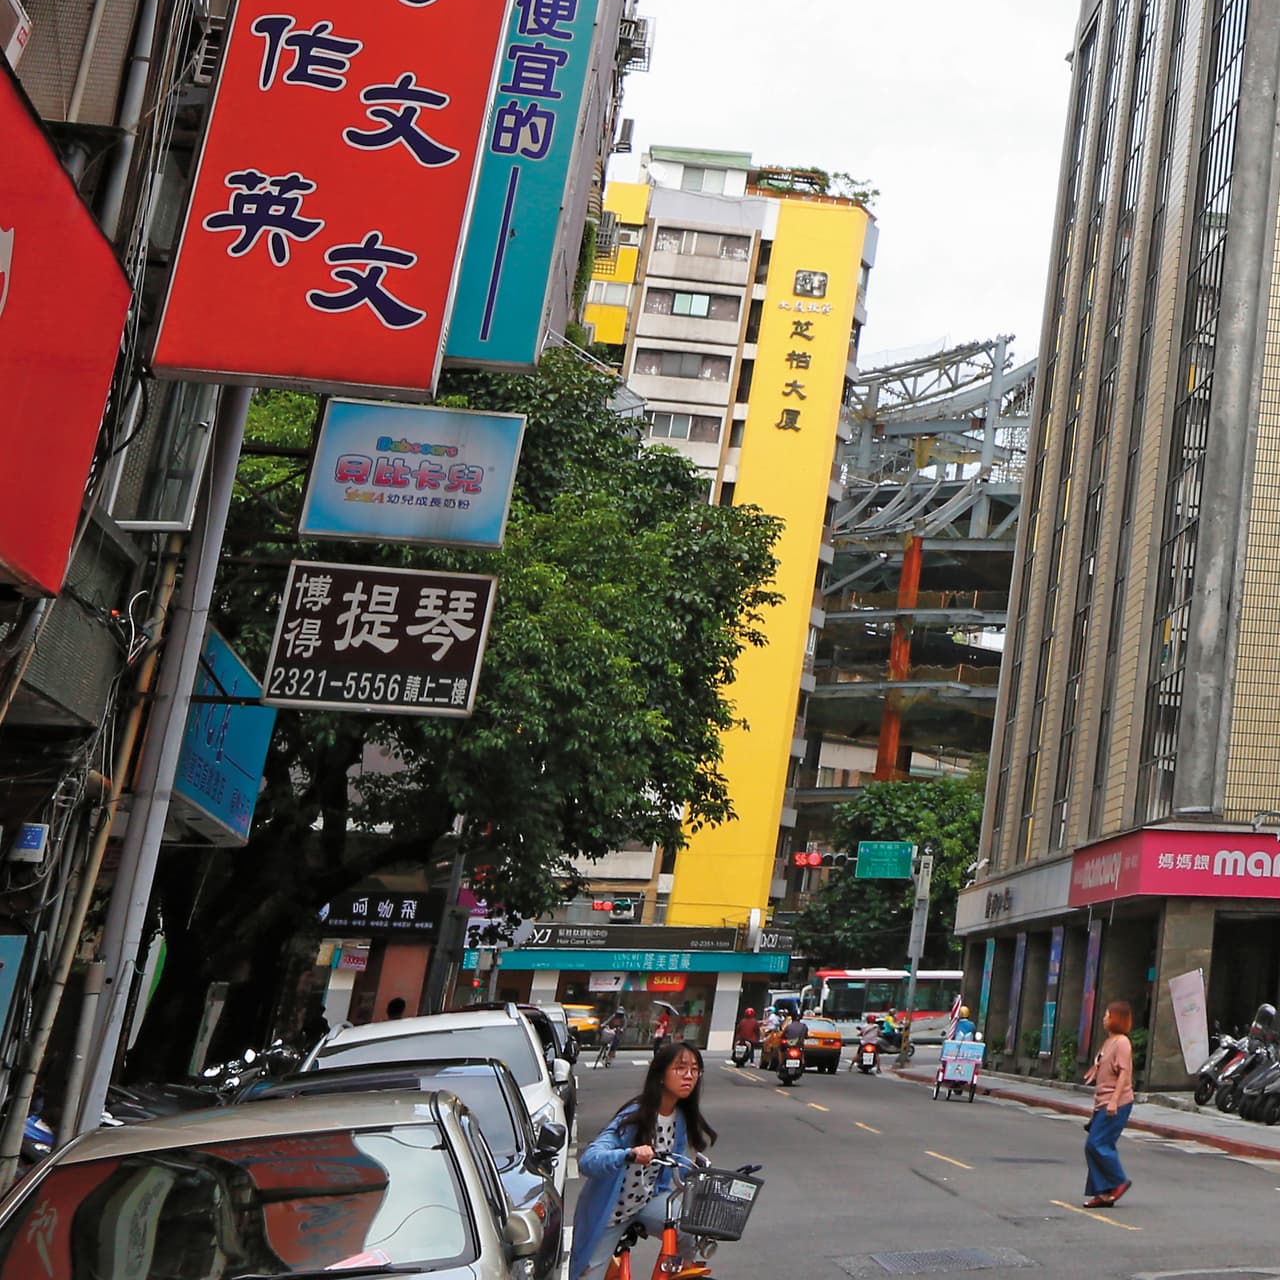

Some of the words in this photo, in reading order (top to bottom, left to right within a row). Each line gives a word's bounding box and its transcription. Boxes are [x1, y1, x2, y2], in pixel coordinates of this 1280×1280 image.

[335, 454, 485, 494] 貝比卡兒
[284, 573, 333, 658] 博得
[334, 580, 478, 662] 提琴
[270, 667, 401, 702] 2321-5556
[402, 674, 469, 705] 請上二樓
[1157, 852, 1210, 870] 媽媽餵
[653, 976, 681, 985] SALE
